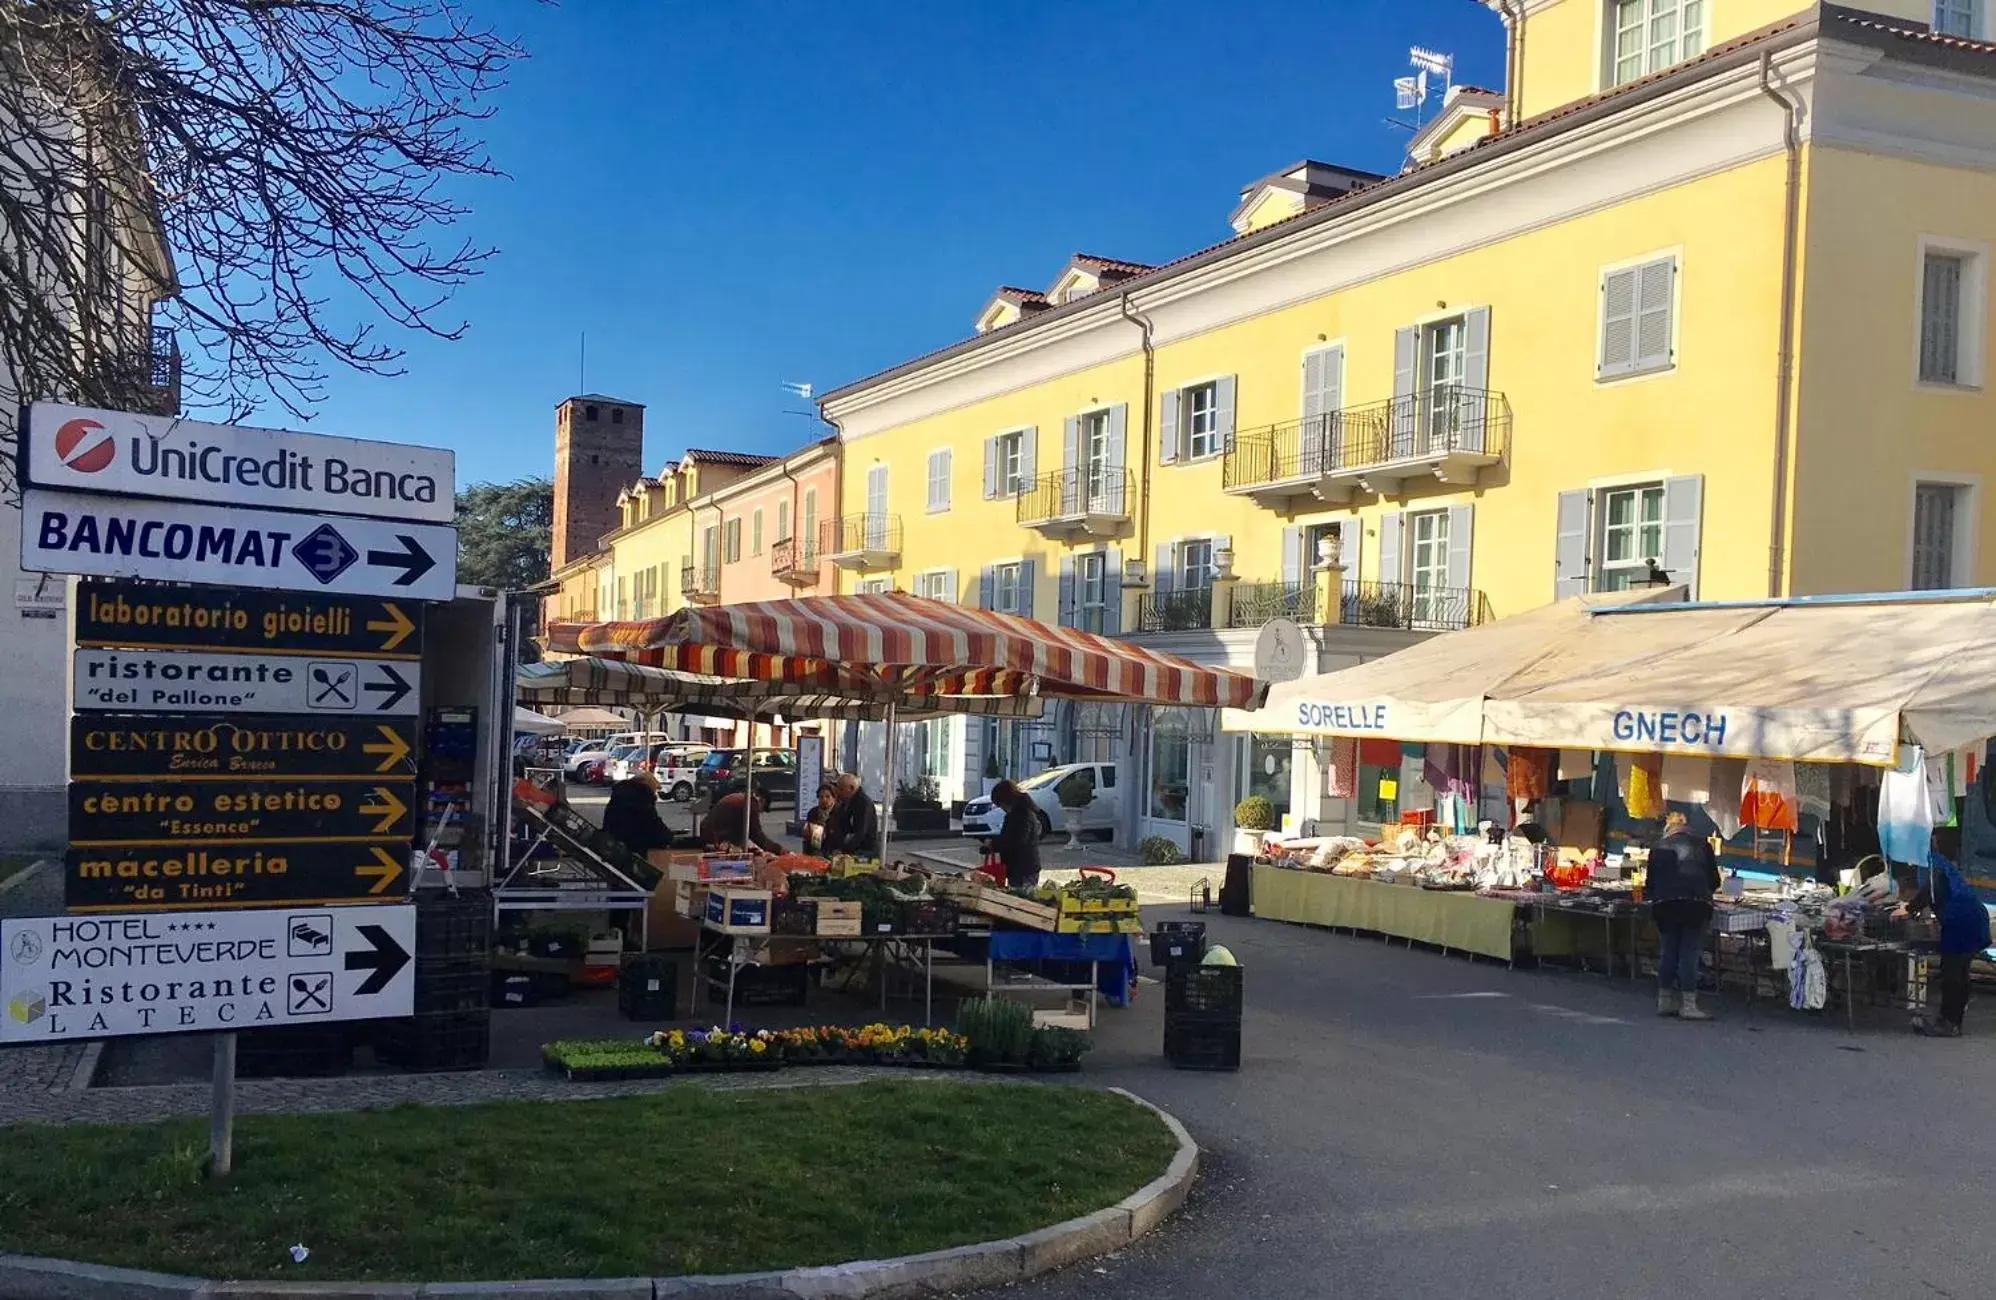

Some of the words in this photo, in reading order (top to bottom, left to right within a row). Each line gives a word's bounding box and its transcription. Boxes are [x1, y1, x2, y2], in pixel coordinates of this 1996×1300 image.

[131, 436, 313, 492] UniCredit
[324, 458, 436, 503] Banca
[38, 510, 291, 568] BANCOMAT
[90, 593, 248, 629] laboratorio
[263, 606, 351, 640] gioielli
[88, 656, 293, 683] ristorante
[1299, 703, 1386, 729] SORELLE
[1613, 711, 1727, 745] GNECH
[85, 729, 218, 753] CENTRO
[232, 729, 347, 752] OTTICO
[83, 793, 194, 815] centro
[214, 788, 342, 812] estetico
[79, 851, 288, 878] macelleria
[52, 918, 161, 943] HOTEL
[51, 939, 277, 970] MONTEVERDE
[49, 976, 277, 1007] Ristorante
